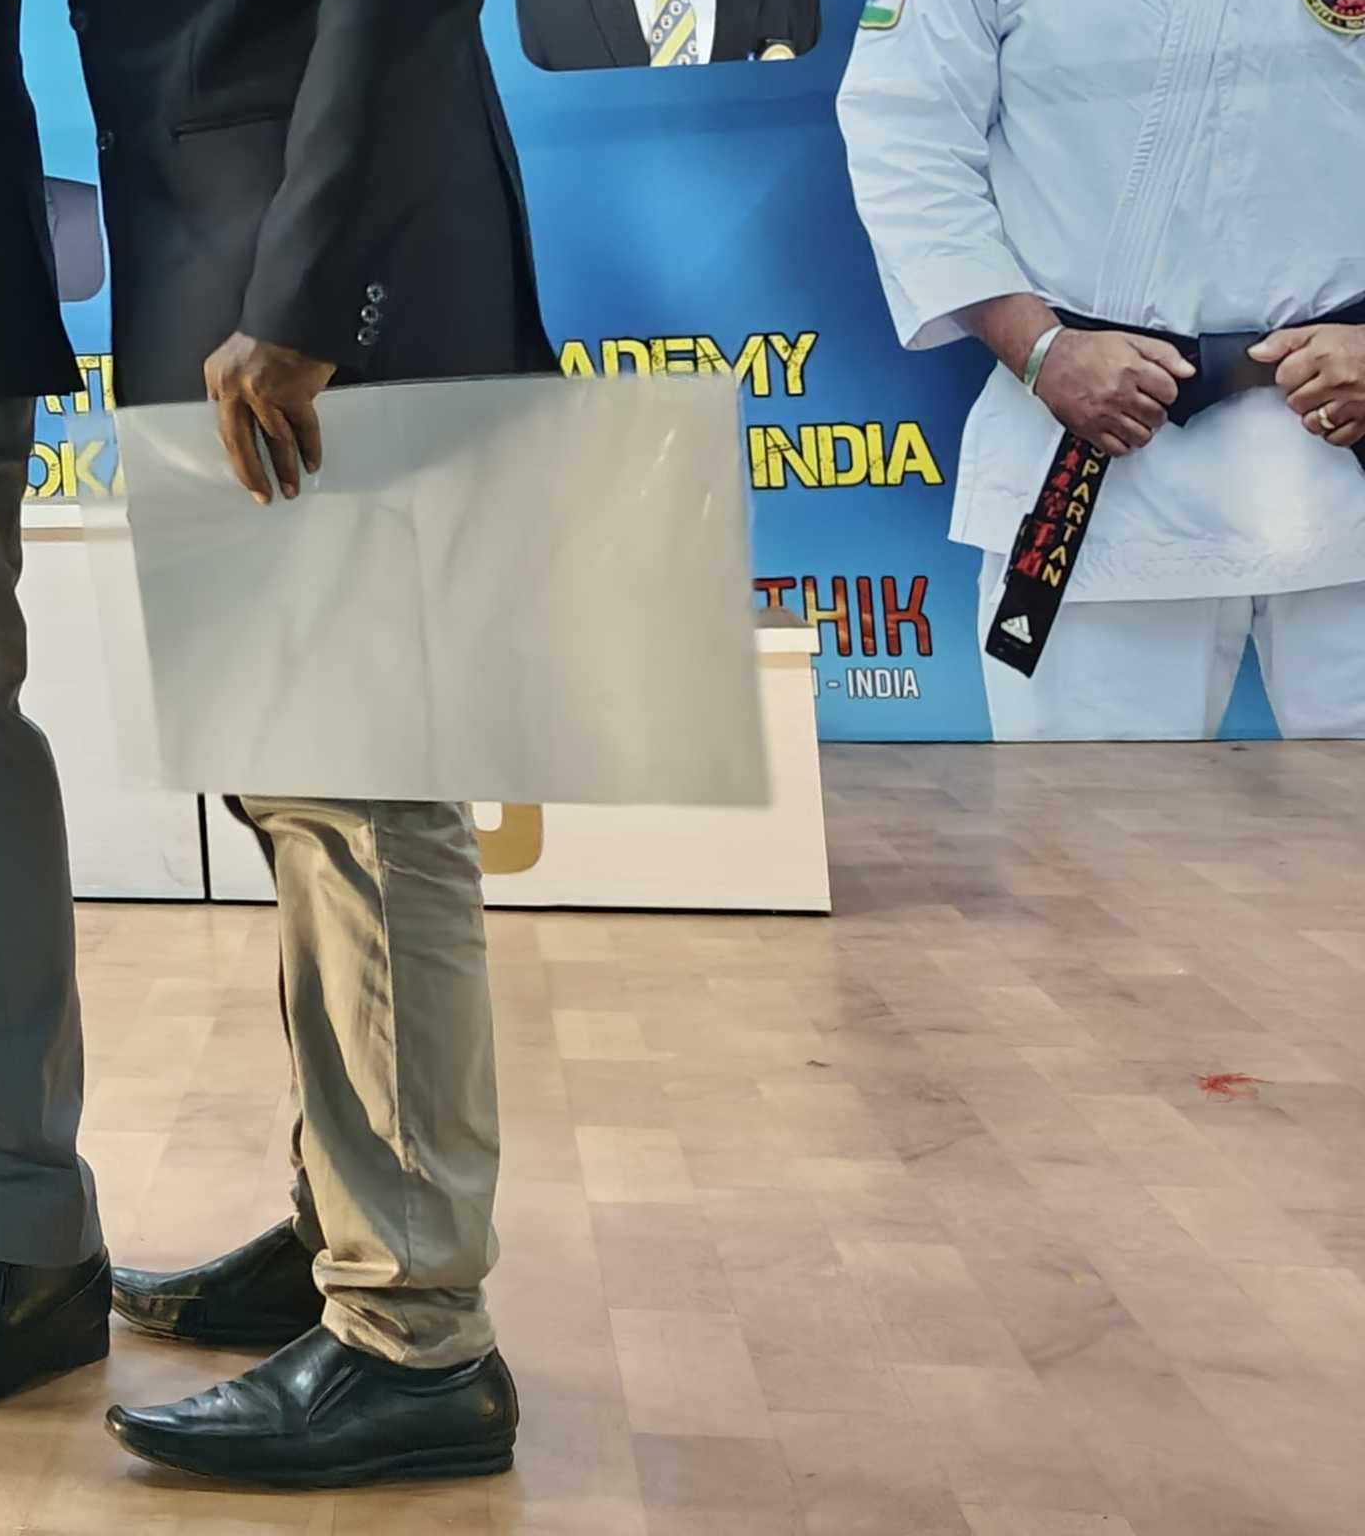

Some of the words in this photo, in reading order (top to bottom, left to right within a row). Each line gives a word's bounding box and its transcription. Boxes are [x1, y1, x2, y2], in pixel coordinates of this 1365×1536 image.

[558, 330, 819, 397] ADEMY
[746, 421, 946, 490] INDIA
[753, 575, 934, 658] THIK
[845, 666, 921, 700] INDIA
